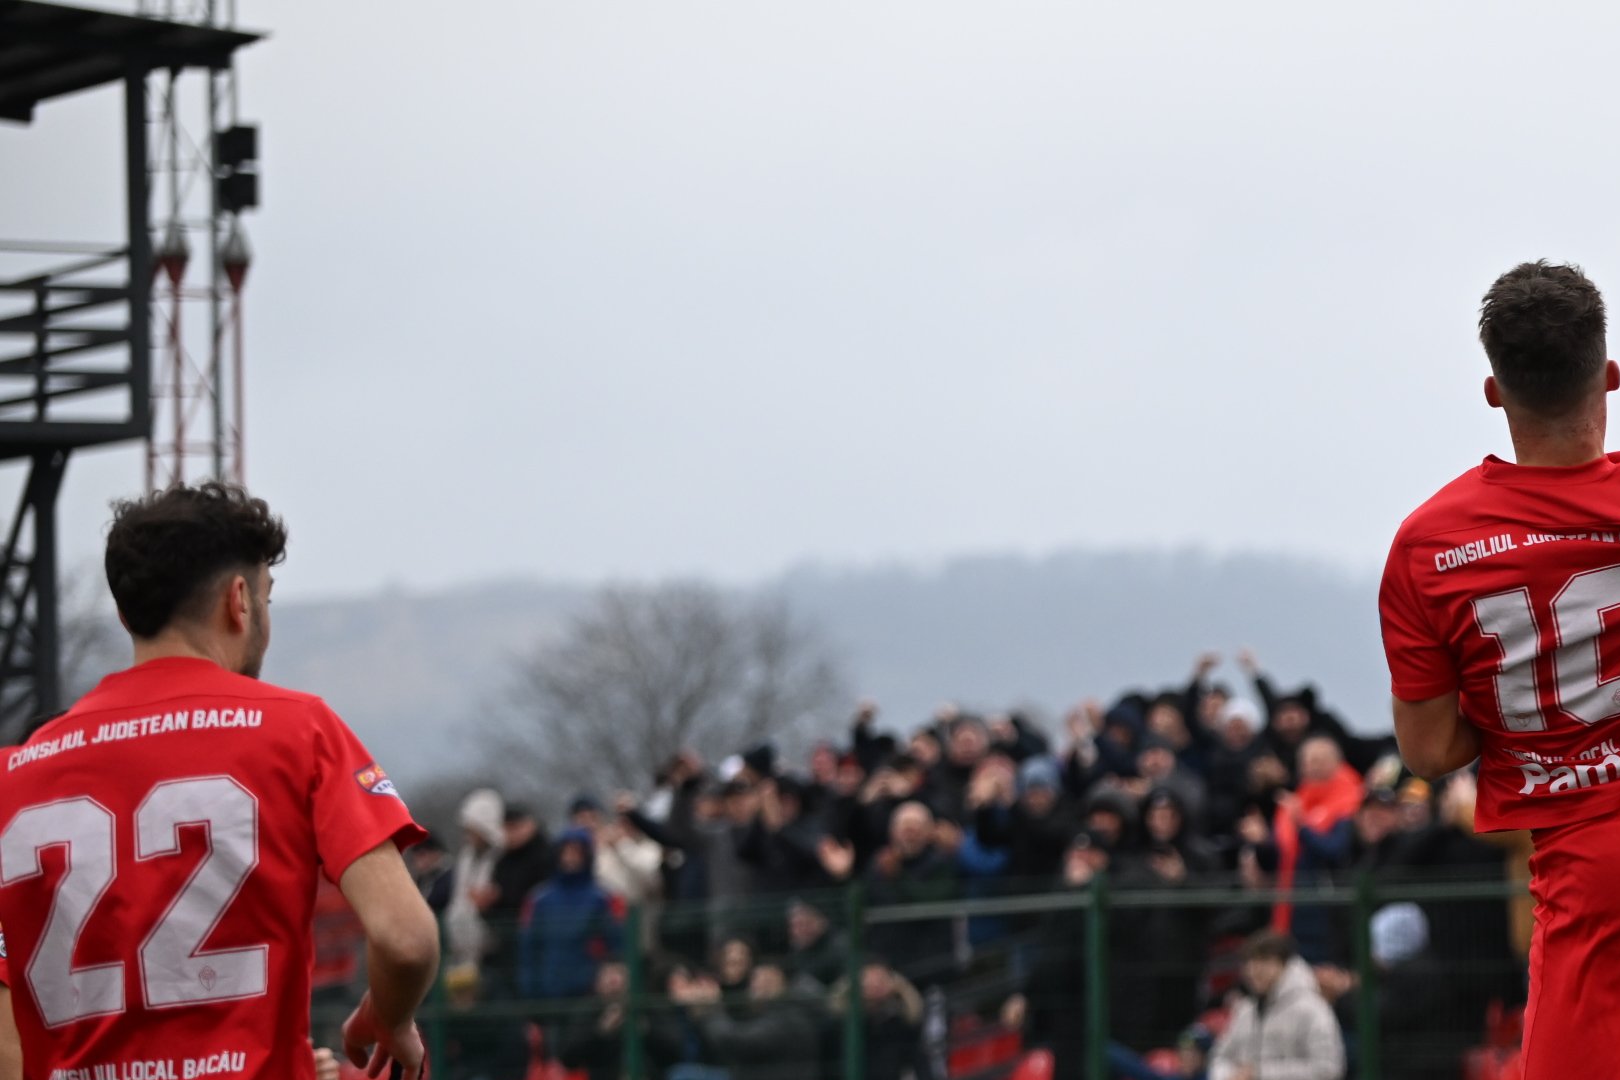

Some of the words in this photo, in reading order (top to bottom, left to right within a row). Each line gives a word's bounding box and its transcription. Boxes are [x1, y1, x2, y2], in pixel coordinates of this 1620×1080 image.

[1434, 533, 1518, 572] CONSILIUL
[8, 729, 87, 772] CONSILIUL
[91, 710, 189, 744] JUDETEAN
[0, 774, 269, 1030] 22
